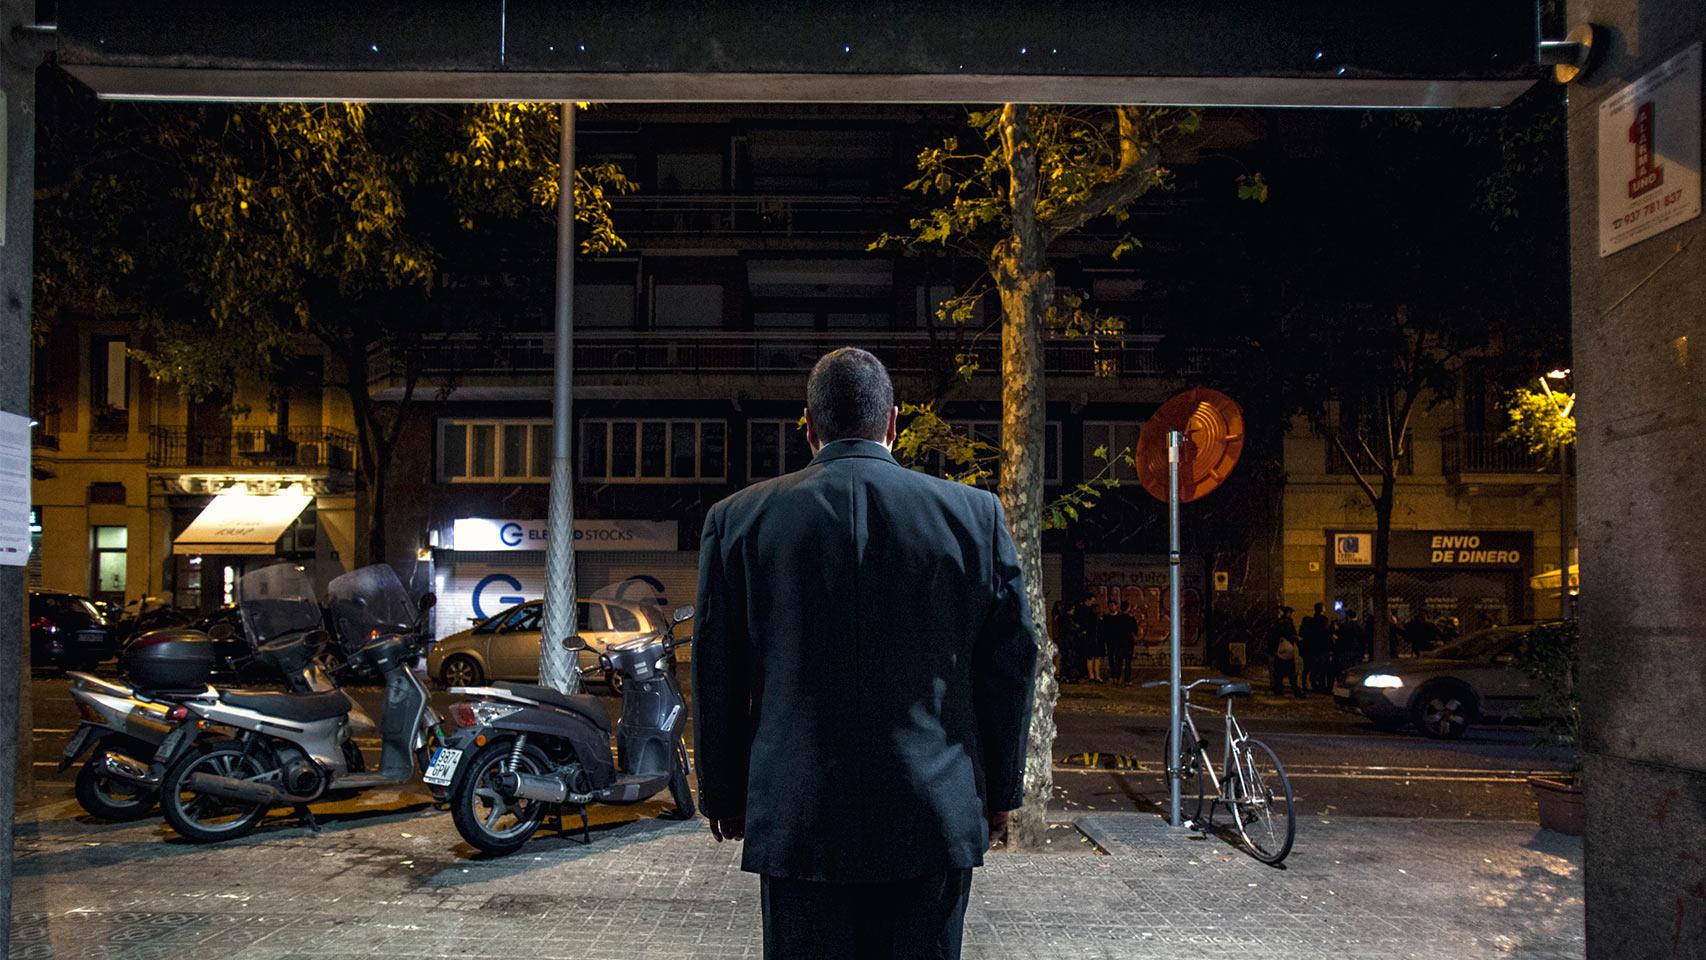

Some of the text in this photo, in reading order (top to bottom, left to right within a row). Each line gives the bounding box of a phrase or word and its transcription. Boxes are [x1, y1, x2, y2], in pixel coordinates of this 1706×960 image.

[1632, 172, 1657, 191] UNO
[1624, 209, 1641, 225] 937
[586, 530, 633, 541] STOCKS
[1431, 536, 1480, 549] ENVIO
[1431, 550, 1520, 563] DE DINERO
